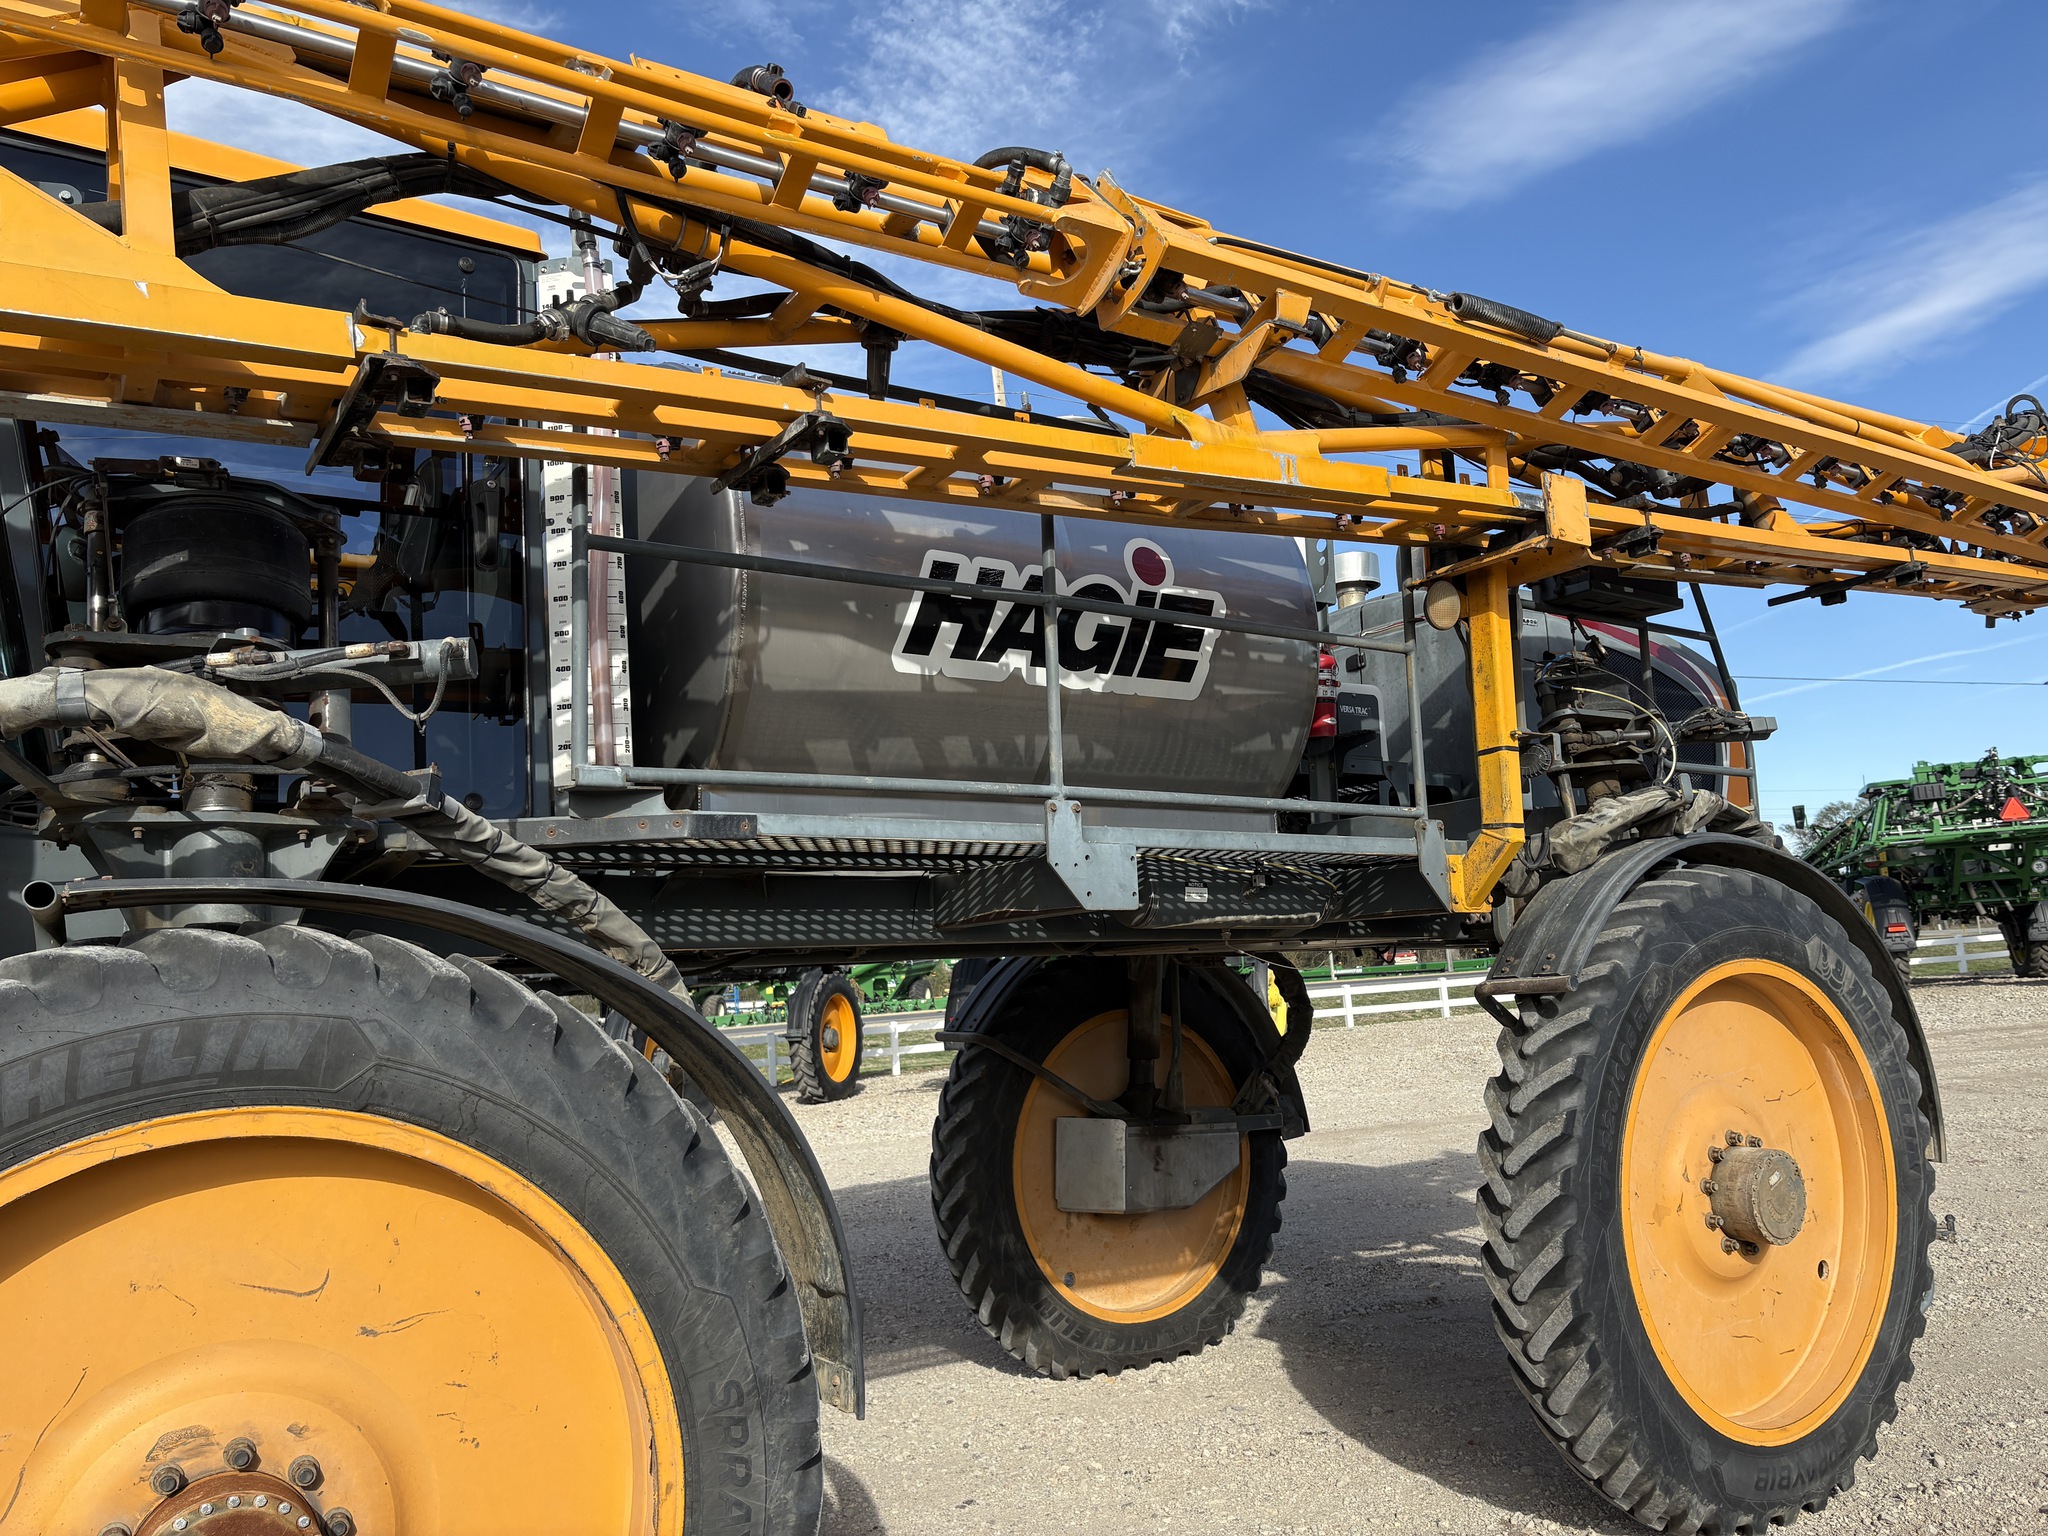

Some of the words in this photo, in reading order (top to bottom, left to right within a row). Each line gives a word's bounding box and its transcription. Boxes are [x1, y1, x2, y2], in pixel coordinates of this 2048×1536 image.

[549, 494, 565, 502] 900
[551, 527, 566, 535] 800
[553, 560, 567, 568] 700
[556, 703, 572, 711] 300
[1340, 705, 1354, 714] VERSA
[707, 1379, 753, 1536] SPRA
